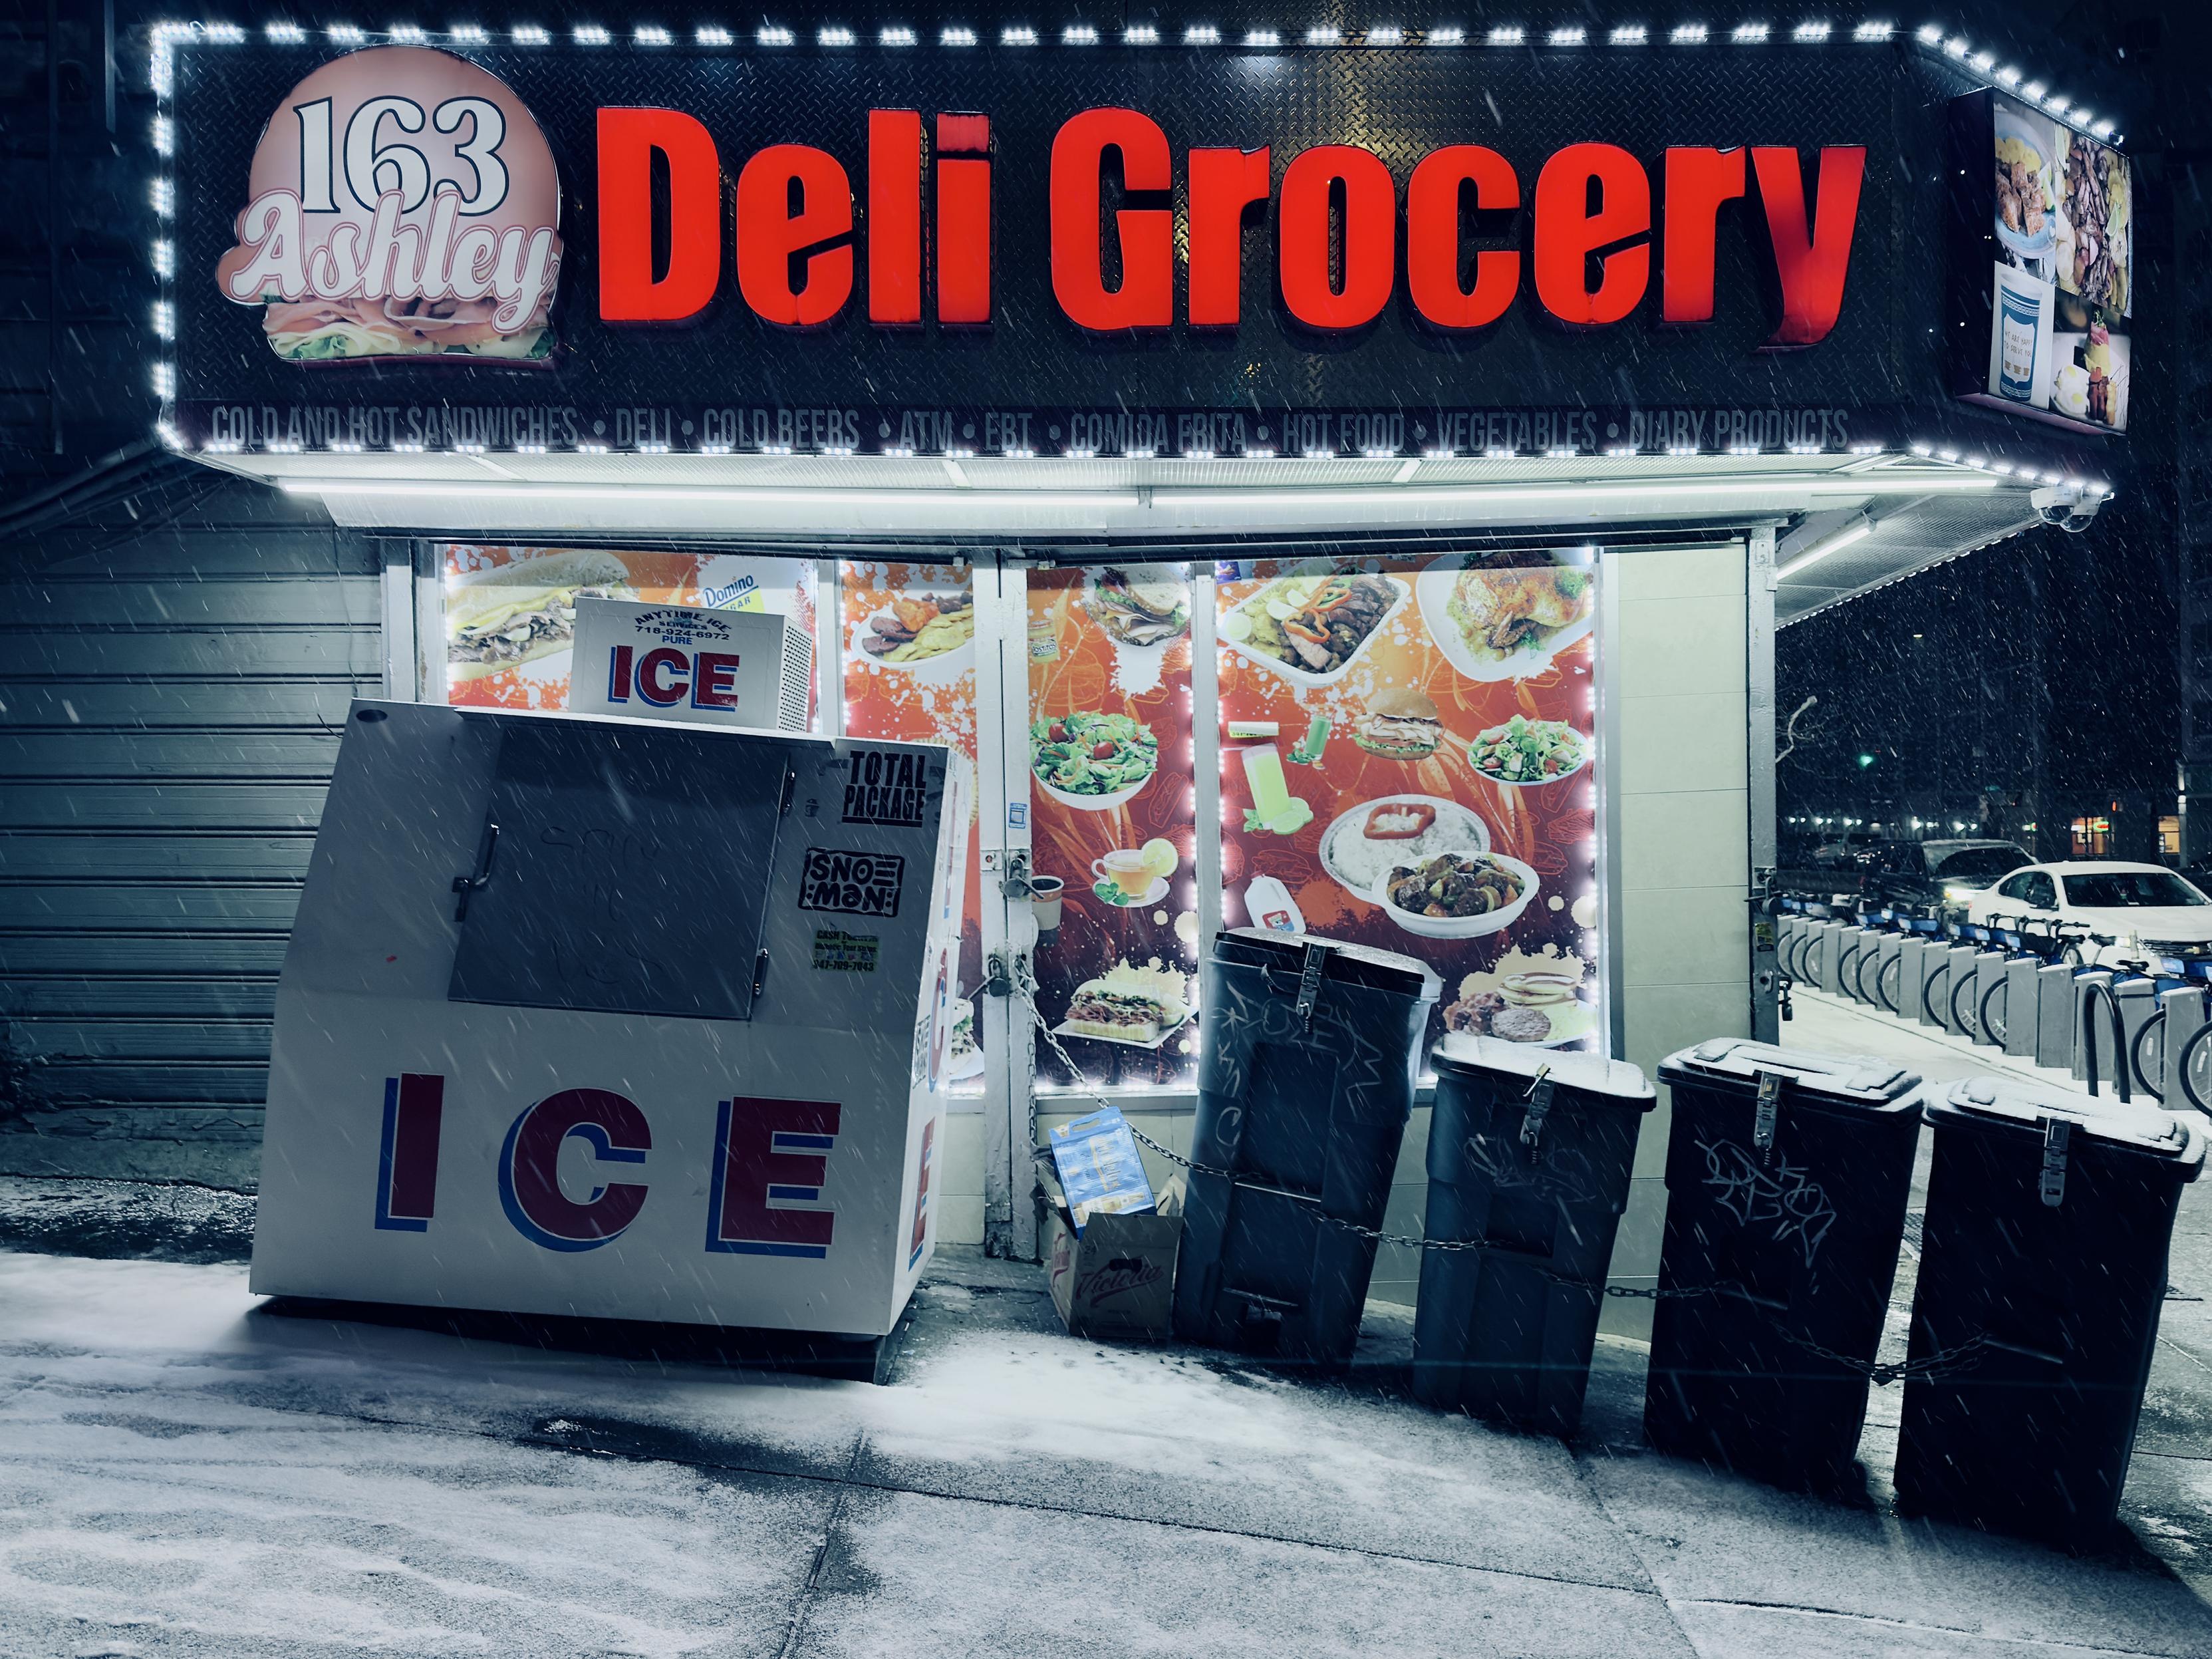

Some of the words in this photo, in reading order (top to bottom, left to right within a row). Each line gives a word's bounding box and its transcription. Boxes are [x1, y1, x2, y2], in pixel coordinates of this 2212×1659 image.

[293, 96, 509, 217] 163
[597, 106, 991, 325] Deli
[1049, 106, 1867, 348] Grocery
[228, 188, 561, 335] Ashley
[211, 406, 278, 445] COLD
[287, 406, 342, 446] AND
[347, 406, 400, 446] HOT
[406, 406, 577, 446] SANDWICHES
[617, 408, 672, 446] DELI
[704, 408, 769, 448] COLD
[778, 408, 859, 449] BEERS
[899, 411, 954, 450] ATM
[985, 412, 1033, 451] EBT
[1071, 412, 1169, 451] COMIDA
[1177, 412, 1248, 451] FRITA
[1283, 412, 1333, 451] HOT
[1339, 412, 1405, 451] FOOD
[1437, 412, 1597, 451] VEGETABLES
[1629, 410, 1707, 450] DIARY
[1715, 408, 1849, 450] PRODUCTS
[703, 575, 754, 607] Domino
[634, 609, 705, 625] ANYTIME
[706, 617, 732, 633] ICE
[635, 625, 730, 641] 718-924-6972
[662, 635, 694, 645] PURE
[608, 645, 740, 712] ICE
[849, 750, 927, 788] TOTAL
[842, 785, 926, 821] PACKAGE
[817, 930, 839, 940] CASH
[374, 1072, 842, 1259] ICE
